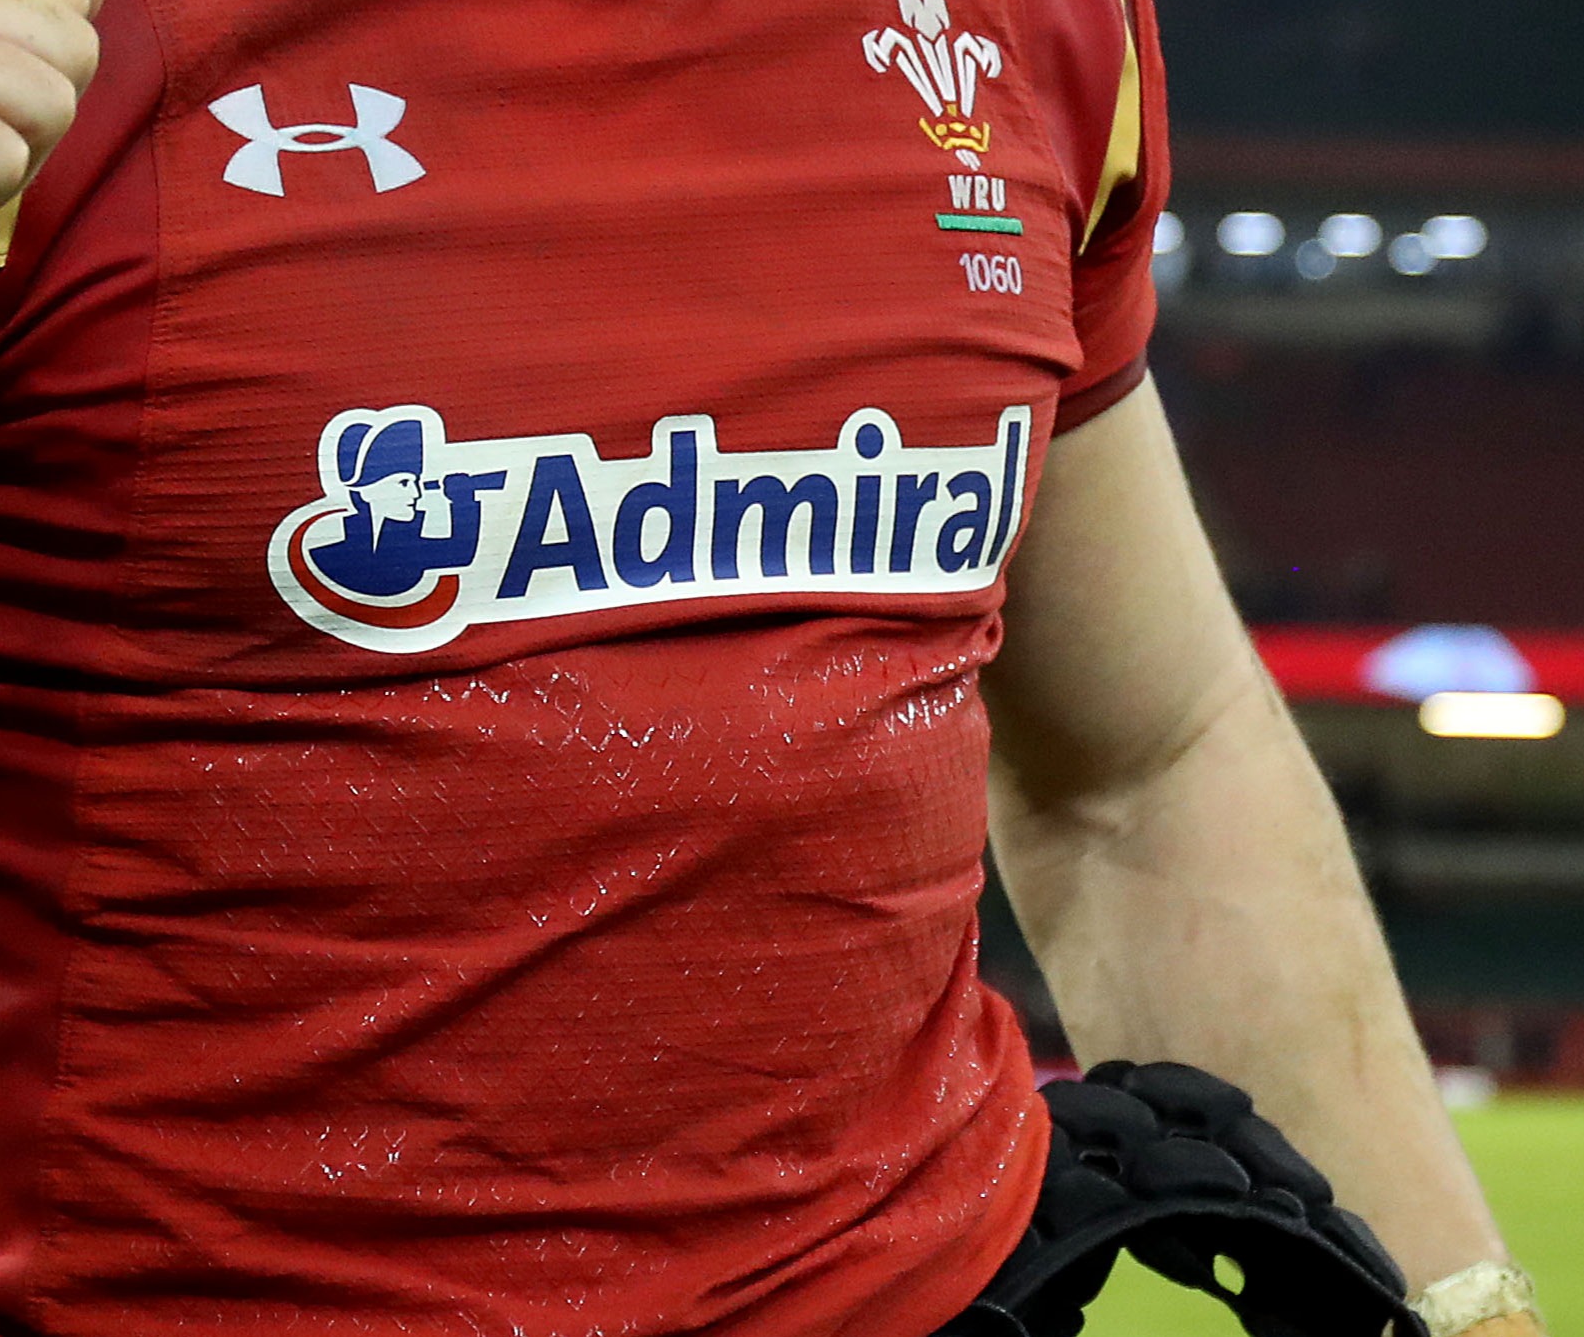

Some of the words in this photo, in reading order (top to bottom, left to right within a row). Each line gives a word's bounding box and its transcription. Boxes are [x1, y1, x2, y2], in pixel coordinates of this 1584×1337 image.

[948, 174, 1006, 212] WRU
[958, 253, 1023, 295] 1060
[496, 420, 1022, 600] Admiral
